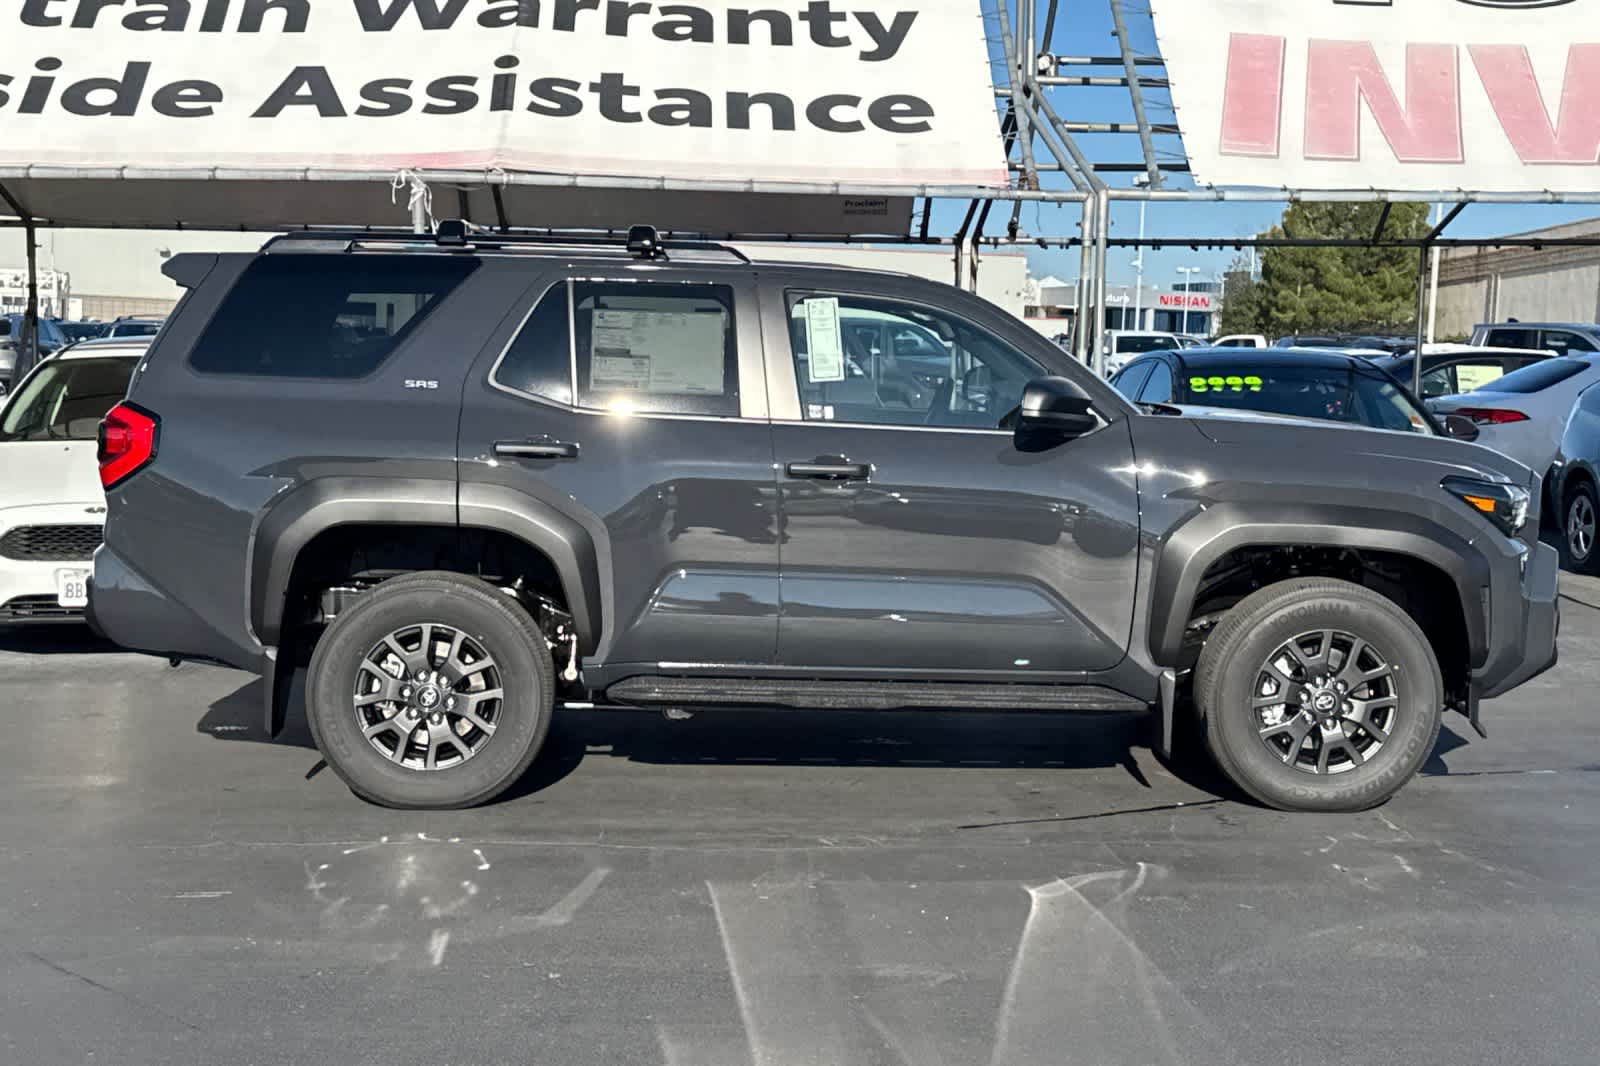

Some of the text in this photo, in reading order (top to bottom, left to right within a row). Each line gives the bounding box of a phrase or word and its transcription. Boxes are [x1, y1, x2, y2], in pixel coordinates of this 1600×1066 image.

[354, 0, 919, 61] Warranty
[0, 54, 935, 134] ide Assistance
[1159, 295, 1210, 308] NISSAN
